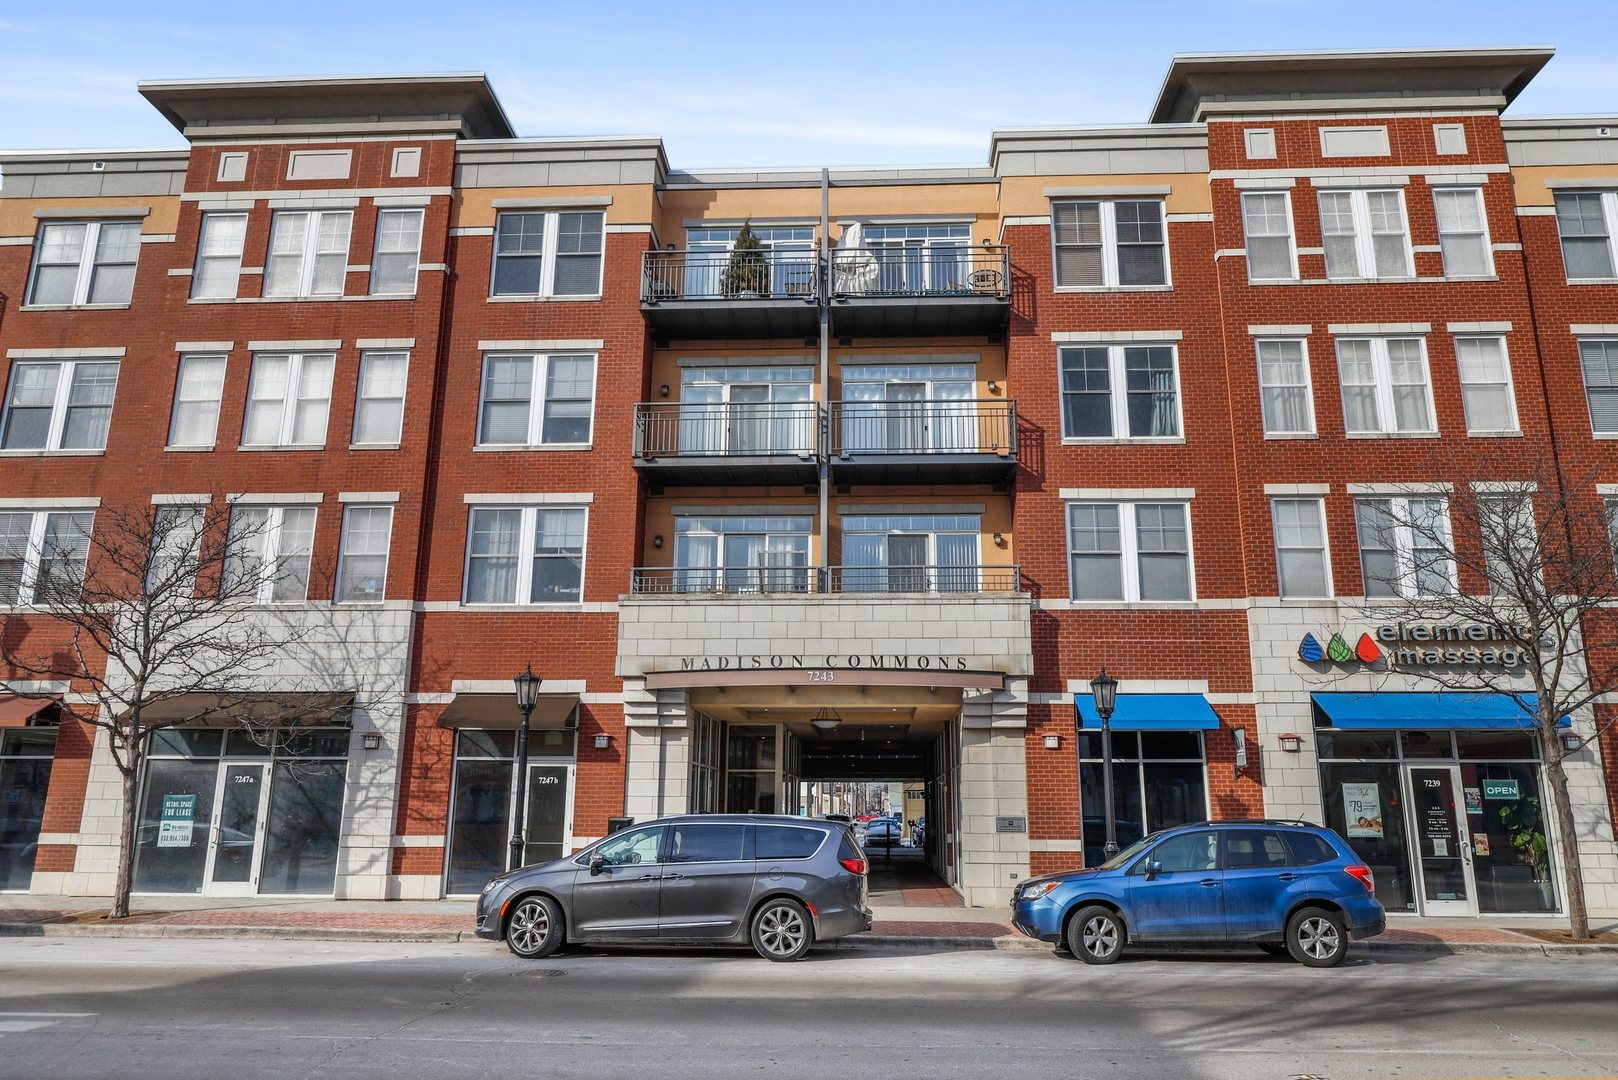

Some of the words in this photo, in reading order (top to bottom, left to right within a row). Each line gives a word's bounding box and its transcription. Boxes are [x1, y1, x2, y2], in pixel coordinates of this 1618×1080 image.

[681, 655, 804, 670] MADISON
[826, 654, 967, 670] COMMONS
[807, 671, 835, 682] 7243
[1424, 780, 1441, 788] 7239
[1486, 787, 1516, 795] OPEN
[164, 808, 175, 816] FOR
[175, 808, 192, 816] LEASE
